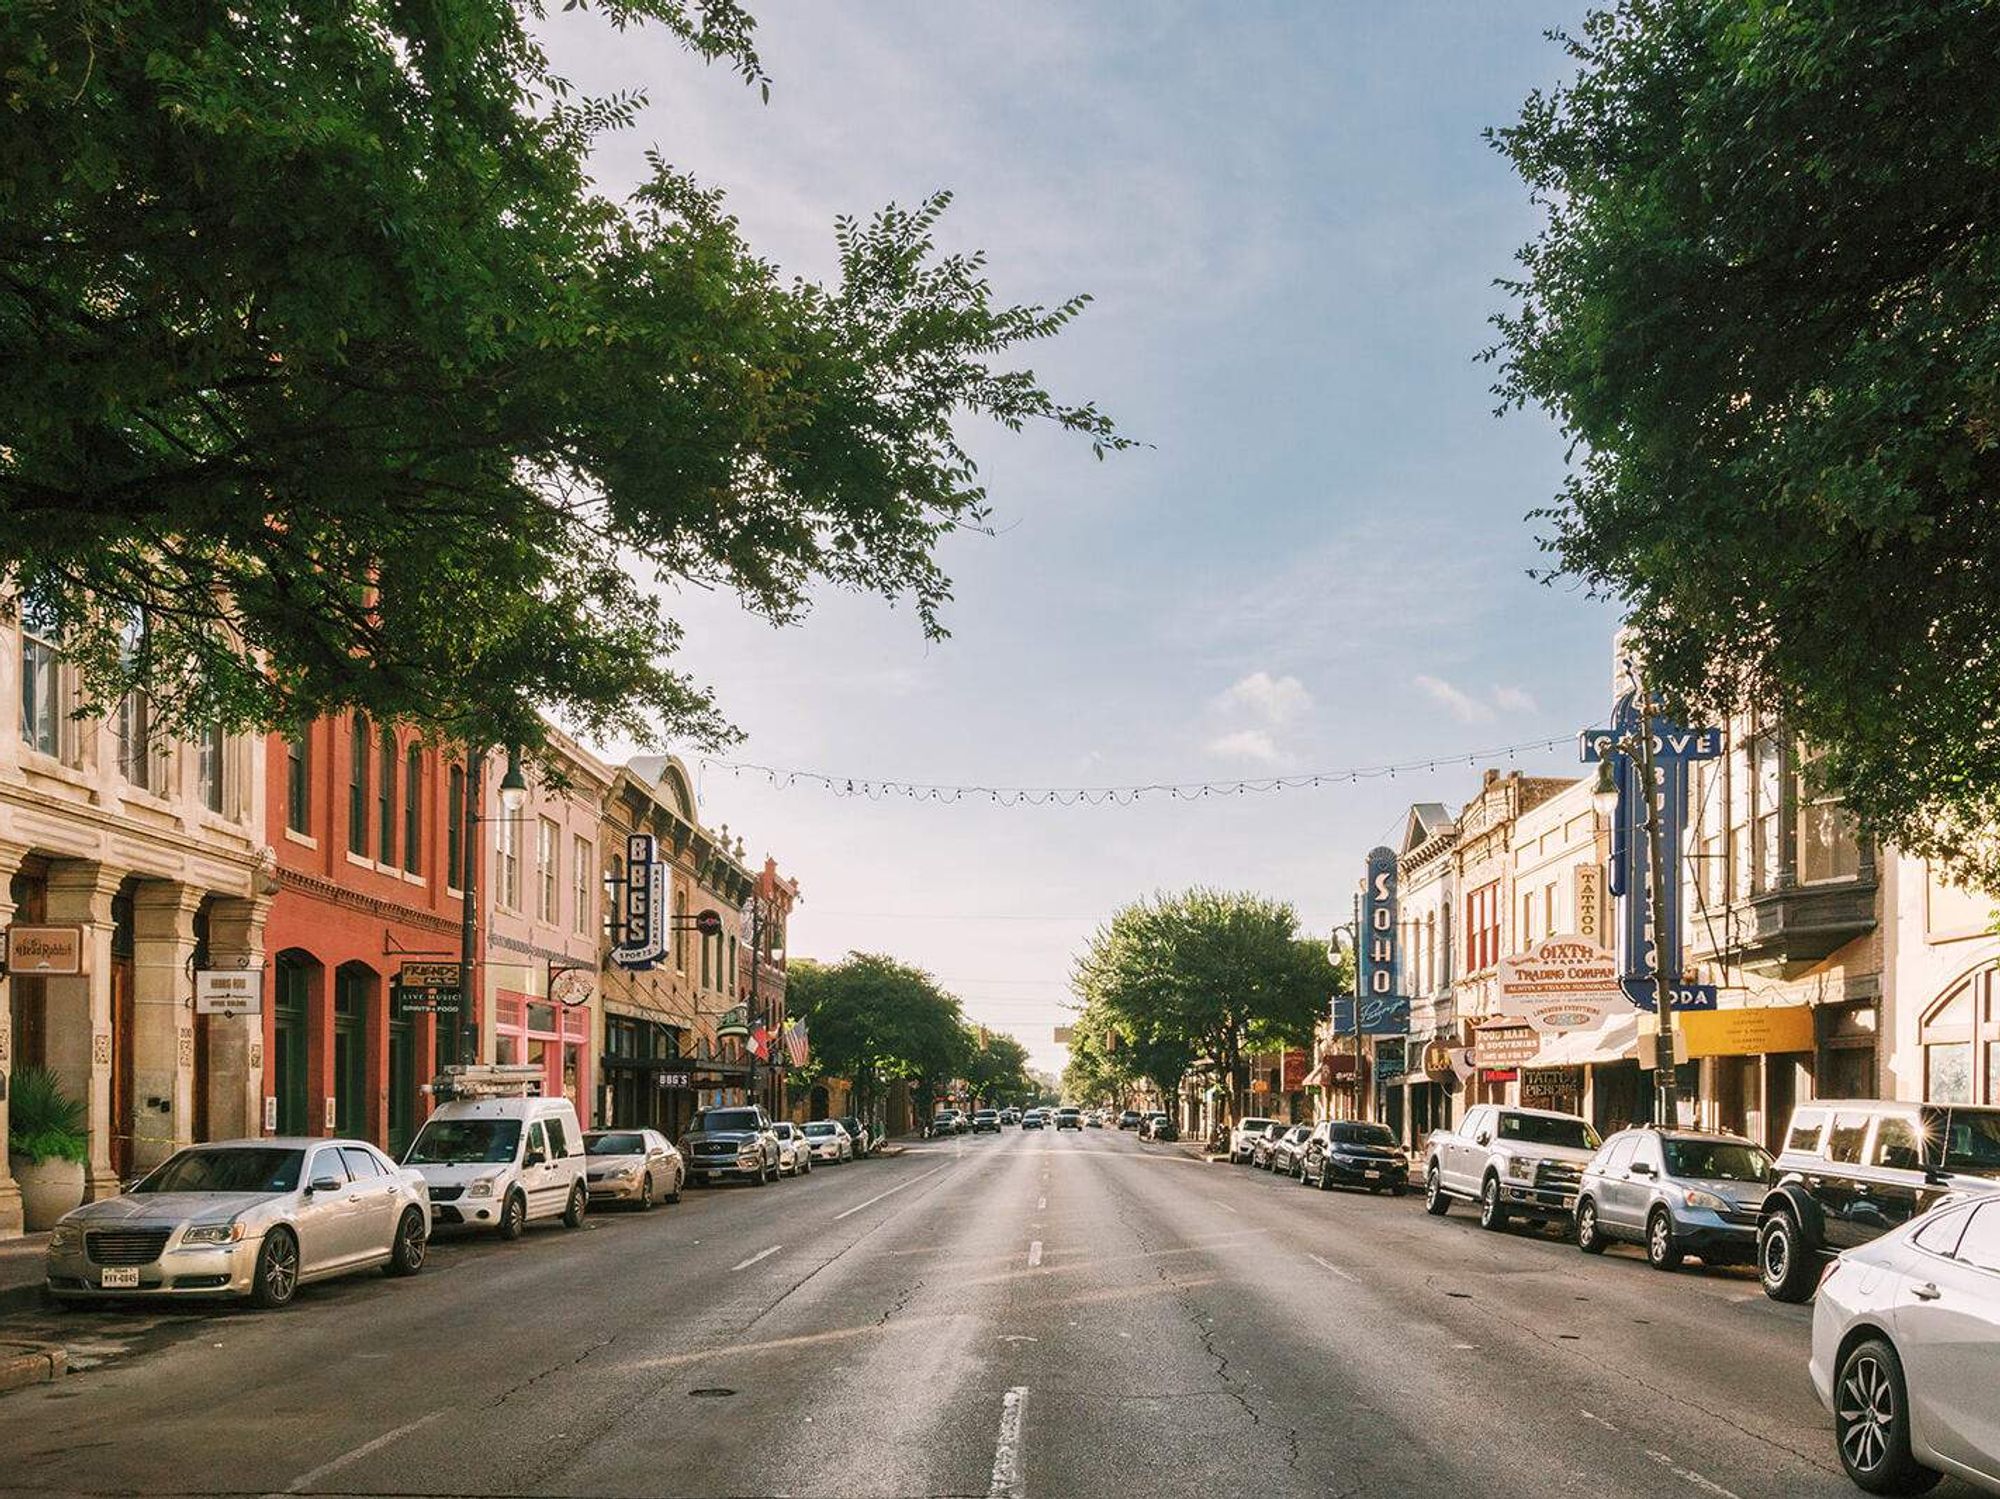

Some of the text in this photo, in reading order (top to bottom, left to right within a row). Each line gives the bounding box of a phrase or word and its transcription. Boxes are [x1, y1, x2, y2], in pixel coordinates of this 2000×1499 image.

[1581, 874, 1594, 935] TATTOO
[1373, 872, 1392, 993] SOHO
[404, 964, 458, 977] FRIENDS
[1515, 967, 1616, 982] TRADING COMPAN
[437, 1005, 459, 1013] FOOD
[659, 1074, 688, 1085] BBG'S
